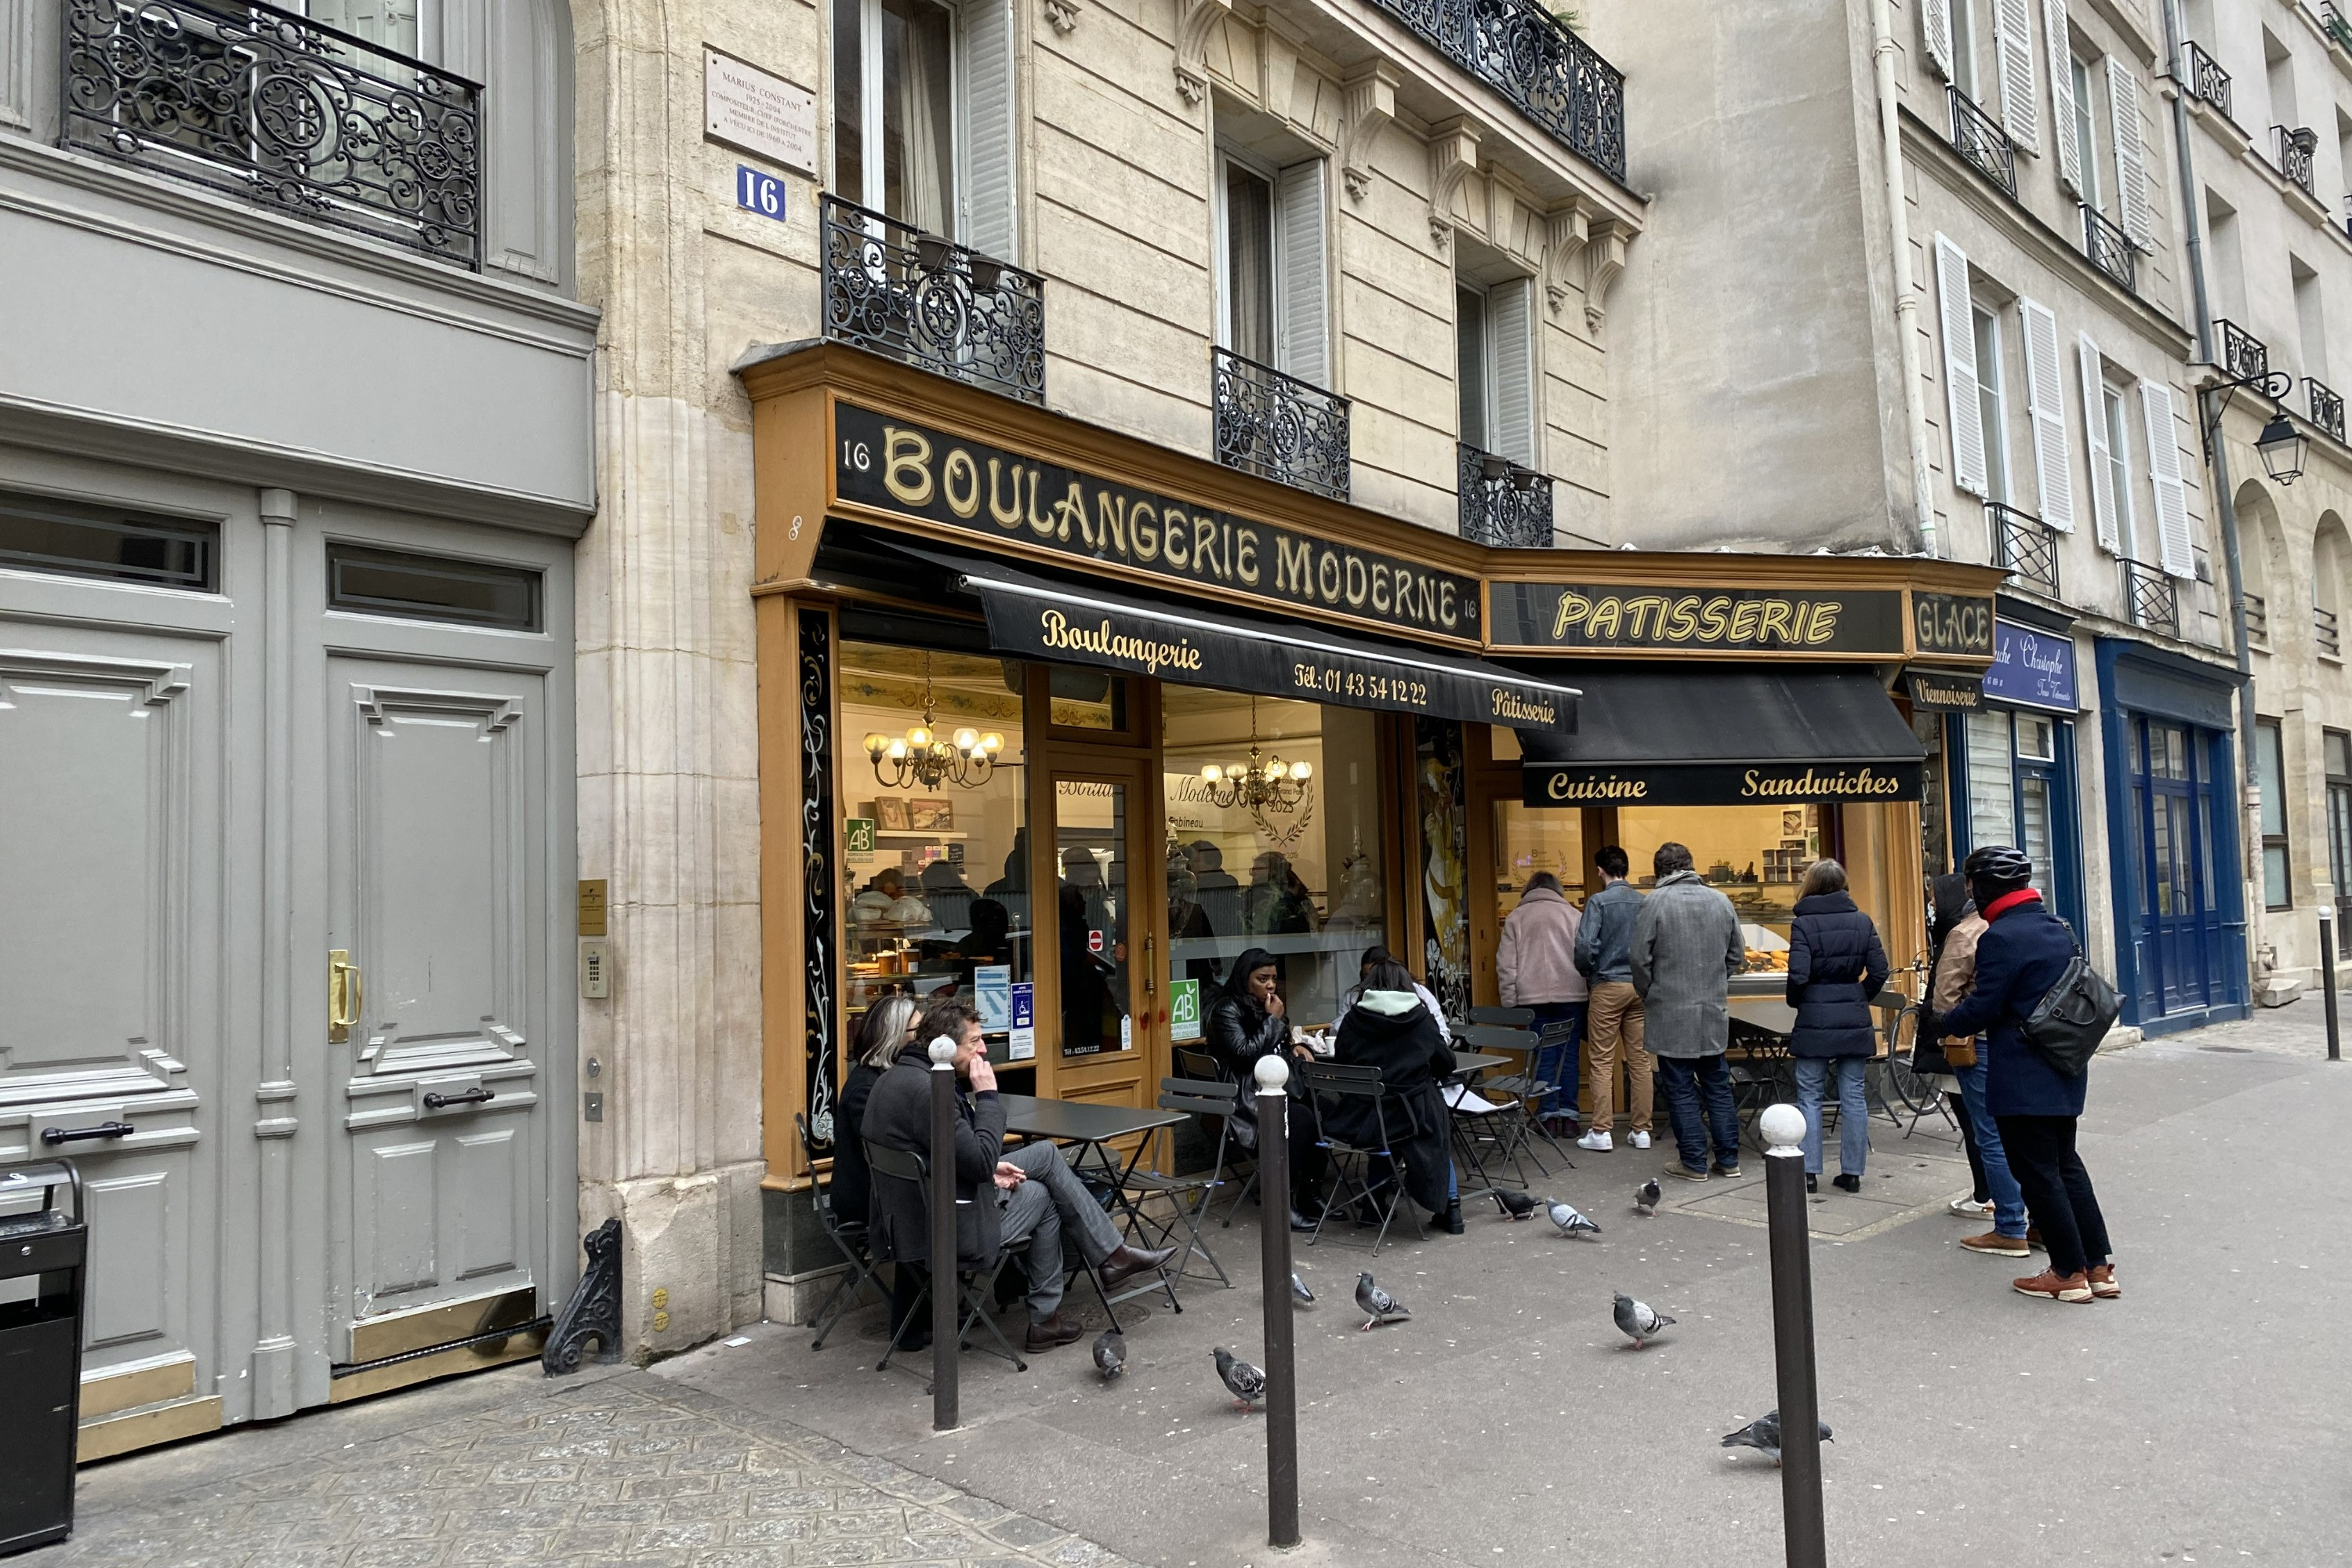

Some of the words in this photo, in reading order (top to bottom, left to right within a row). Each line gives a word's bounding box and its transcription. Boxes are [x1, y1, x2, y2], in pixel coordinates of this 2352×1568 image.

[723, 71, 756, 93] MARIUS
[759, 88, 802, 112] CONSTANT
[746, 94, 760, 107] 1925
[765, 103, 781, 114] 2004
[729, 108, 756, 124] MEMBRE
[757, 109, 772, 121] CHEF
[746, 125, 755, 134] ICI
[766, 130, 780, 143] 1960
[786, 141, 802, 152] 2004
[745, 171, 779, 214] 16
[843, 440, 872, 472] 16
[882, 424, 1260, 586] BOULANGERIE
[1275, 534, 1458, 630] MODERNE
[1464, 598, 1476, 619] 16
[1553, 590, 1842, 644] PATISSERIE
[1918, 601, 1990, 650] GLACE
[1041, 608, 1203, 674] Boulangerie
[1325, 668, 1340, 693] 01
[1345, 673, 1365, 697] 43
[1369, 675, 1388, 699] 54
[1392, 678, 1407, 702] 12
[1410, 681, 1427, 706] 22
[1491, 688, 1556, 724] Pâtisserie
[1916, 677, 1977, 707] Viennoiserie
[1548, 771, 1647, 801] Cuisine
[1740, 768, 1900, 797] Sandwiches
[849, 829, 870, 850] AB
[1173, 993, 1195, 1022] AB
